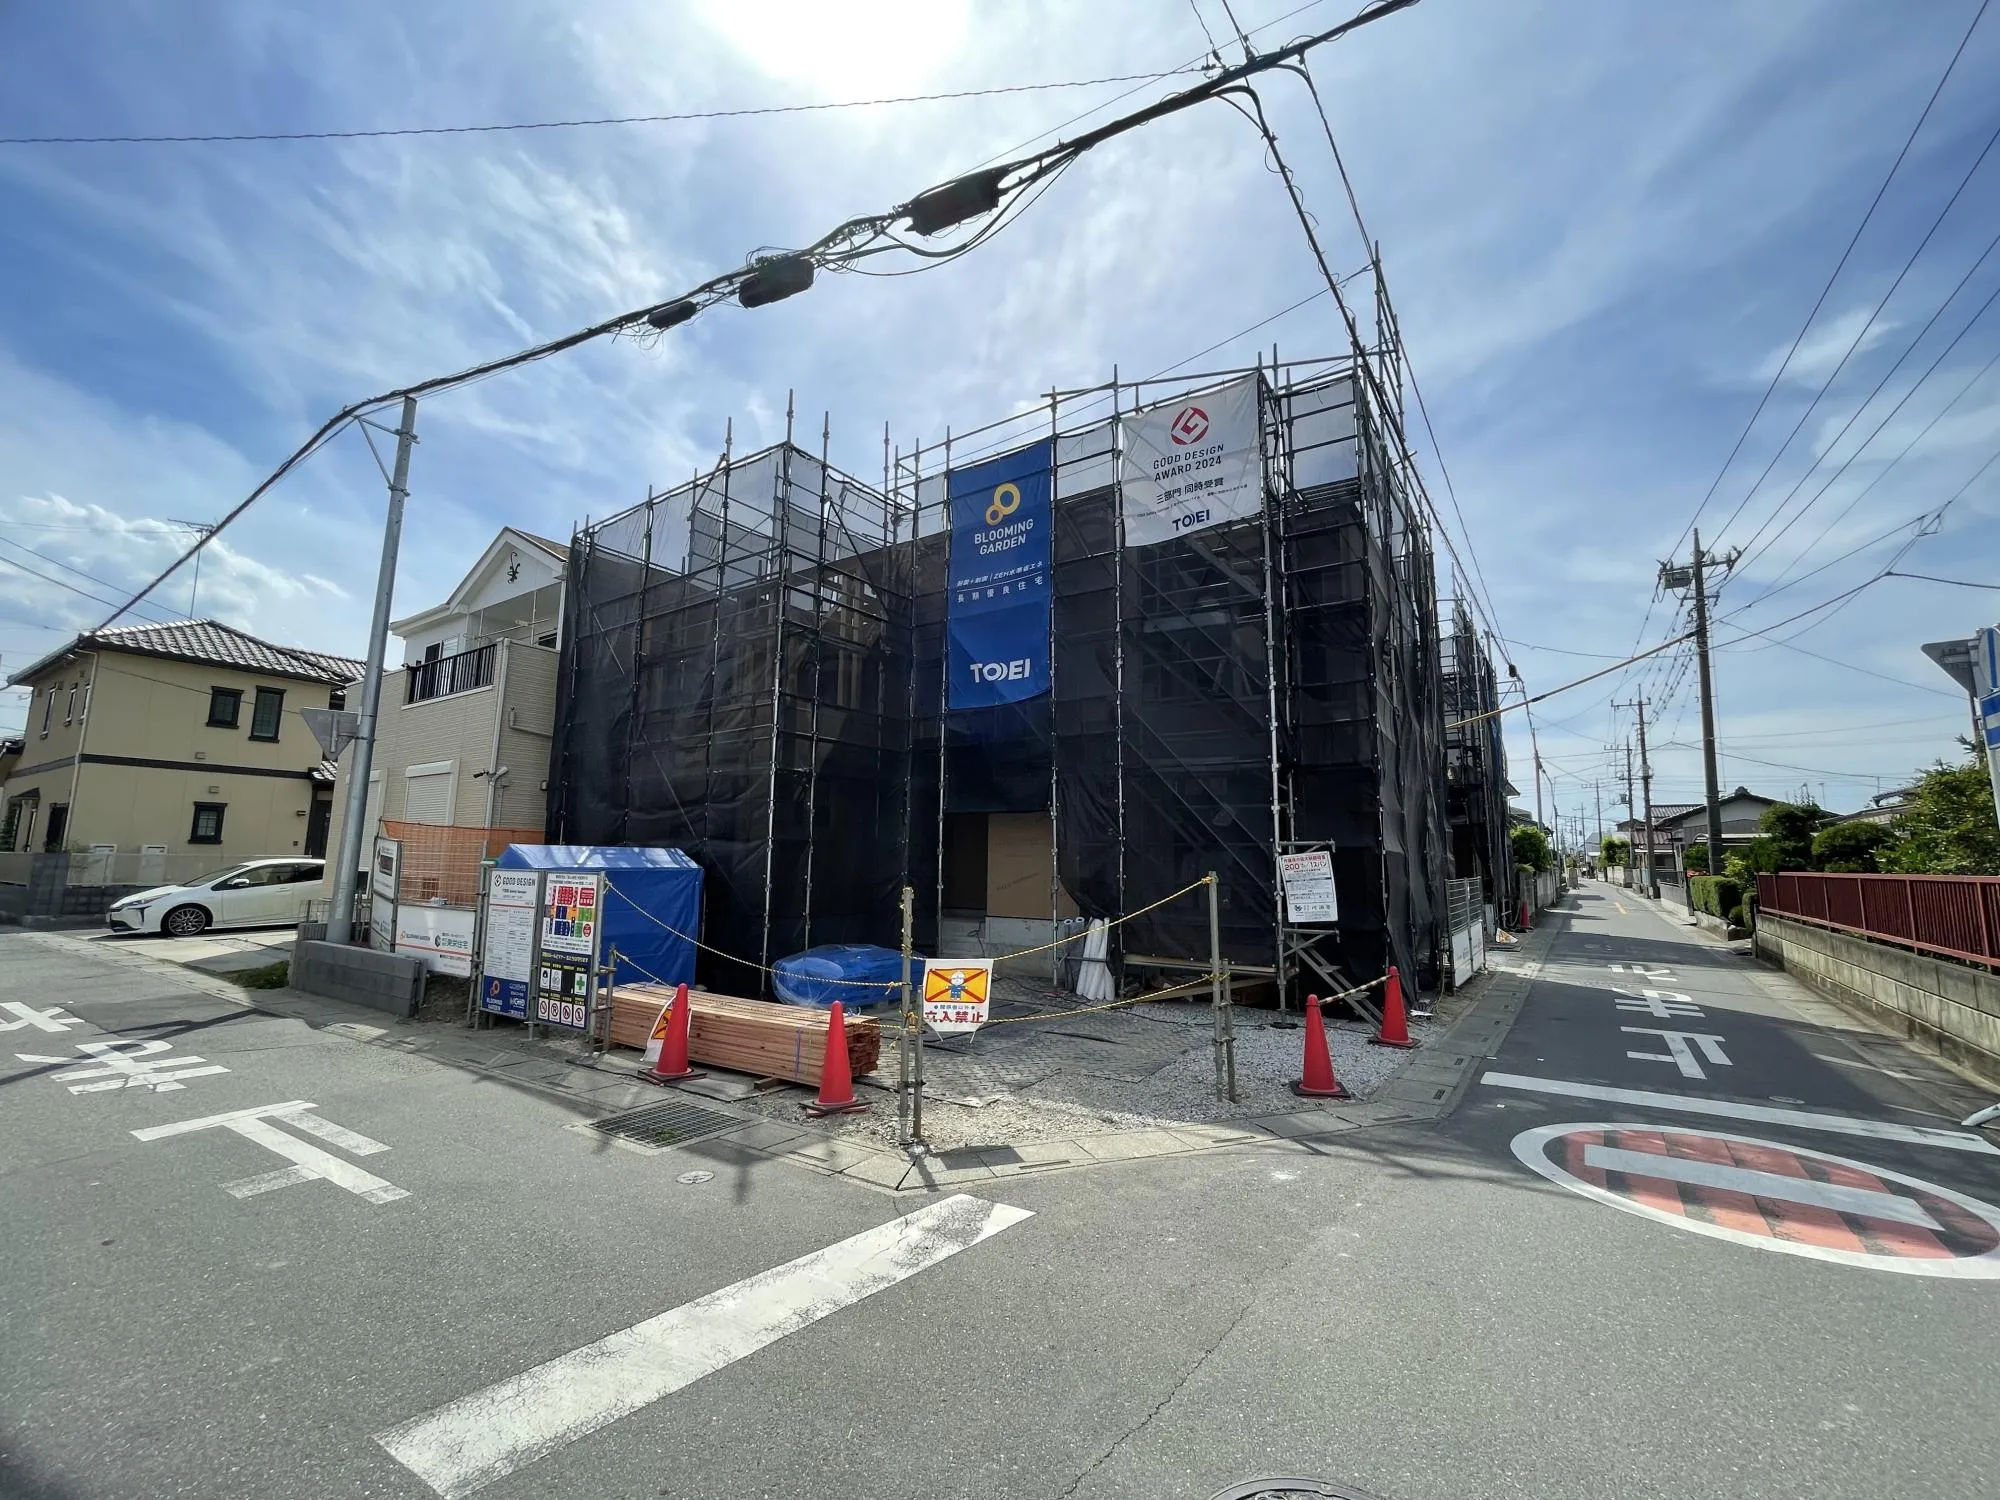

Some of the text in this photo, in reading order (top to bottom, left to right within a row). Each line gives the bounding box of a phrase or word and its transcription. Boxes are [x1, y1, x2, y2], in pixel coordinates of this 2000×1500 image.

[1153, 443, 1224, 470] GOOD DESIGN
[1154, 455, 1222, 482] AWARD 2024
[1156, 487, 1182, 505] 三部門
[1184, 477, 1224, 494] 同時受賞
[974, 519, 1034, 545] BLOOMING
[979, 534, 1026, 556] GARDEN
[956, 575, 1043, 603] 長期優良住宅
[1284, 863, 1300, 871] 200
[516, 878, 536, 887] DESIGN
[925, 1011, 983, 1023] 立入禁止
